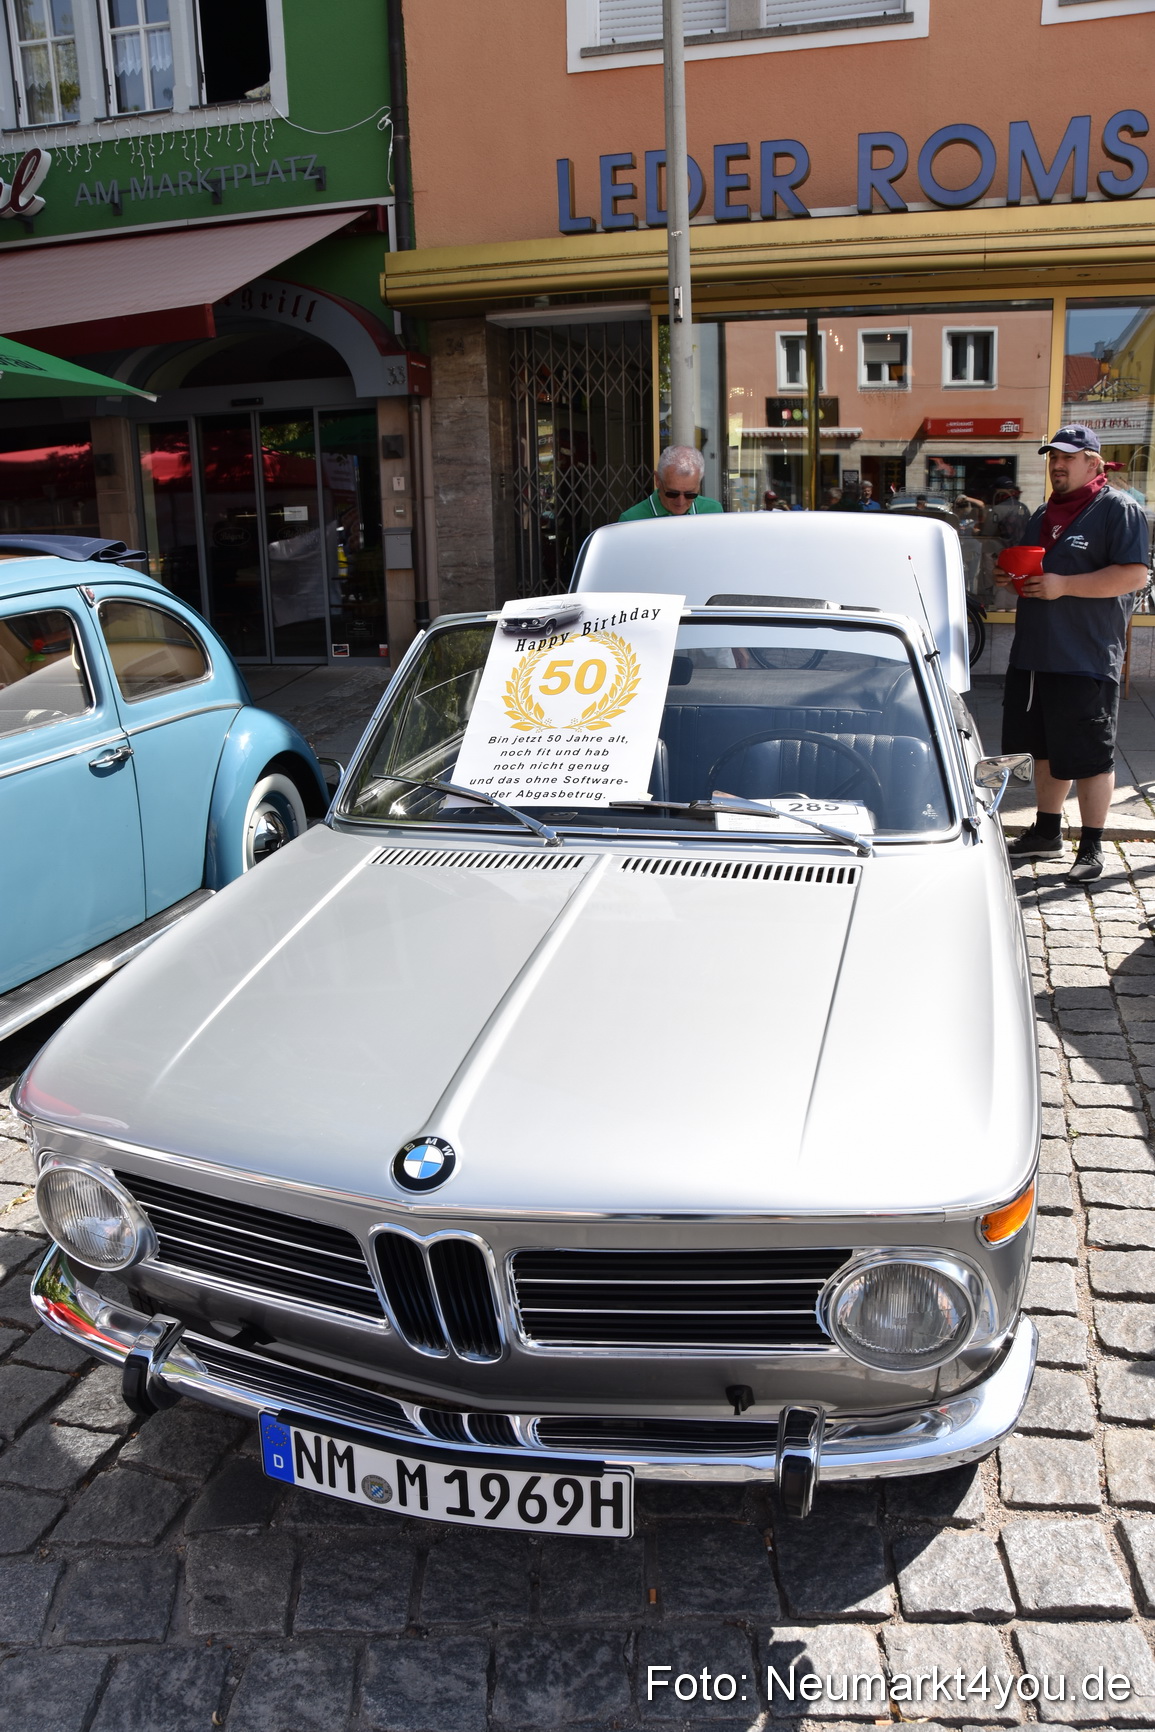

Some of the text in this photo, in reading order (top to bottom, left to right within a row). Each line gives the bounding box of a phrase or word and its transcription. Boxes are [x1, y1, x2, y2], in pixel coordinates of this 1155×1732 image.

[74, 153, 320, 207] AM MARKTPLATZ
[556, 108, 1150, 235] LEDER ROMS
[387, 366, 407, 386] 33
[515, 607, 661, 652] Happy Birthday
[538, 658, 607, 696] 50
[488, 734, 629, 745] Bin jetzt 50 Jahre alt,
[500, 748, 609, 757] noch fit und hab
[493, 762, 610, 772] noch nicht genug
[469, 775, 629, 785] und das ohne Software-
[516, 789, 606, 800] Abgasbetrug.
[788, 803, 840, 812] 285
[404, 1137, 455, 1156] BMW
[273, 1453, 284, 1469] D
[293, 1430, 356, 1494] NM
